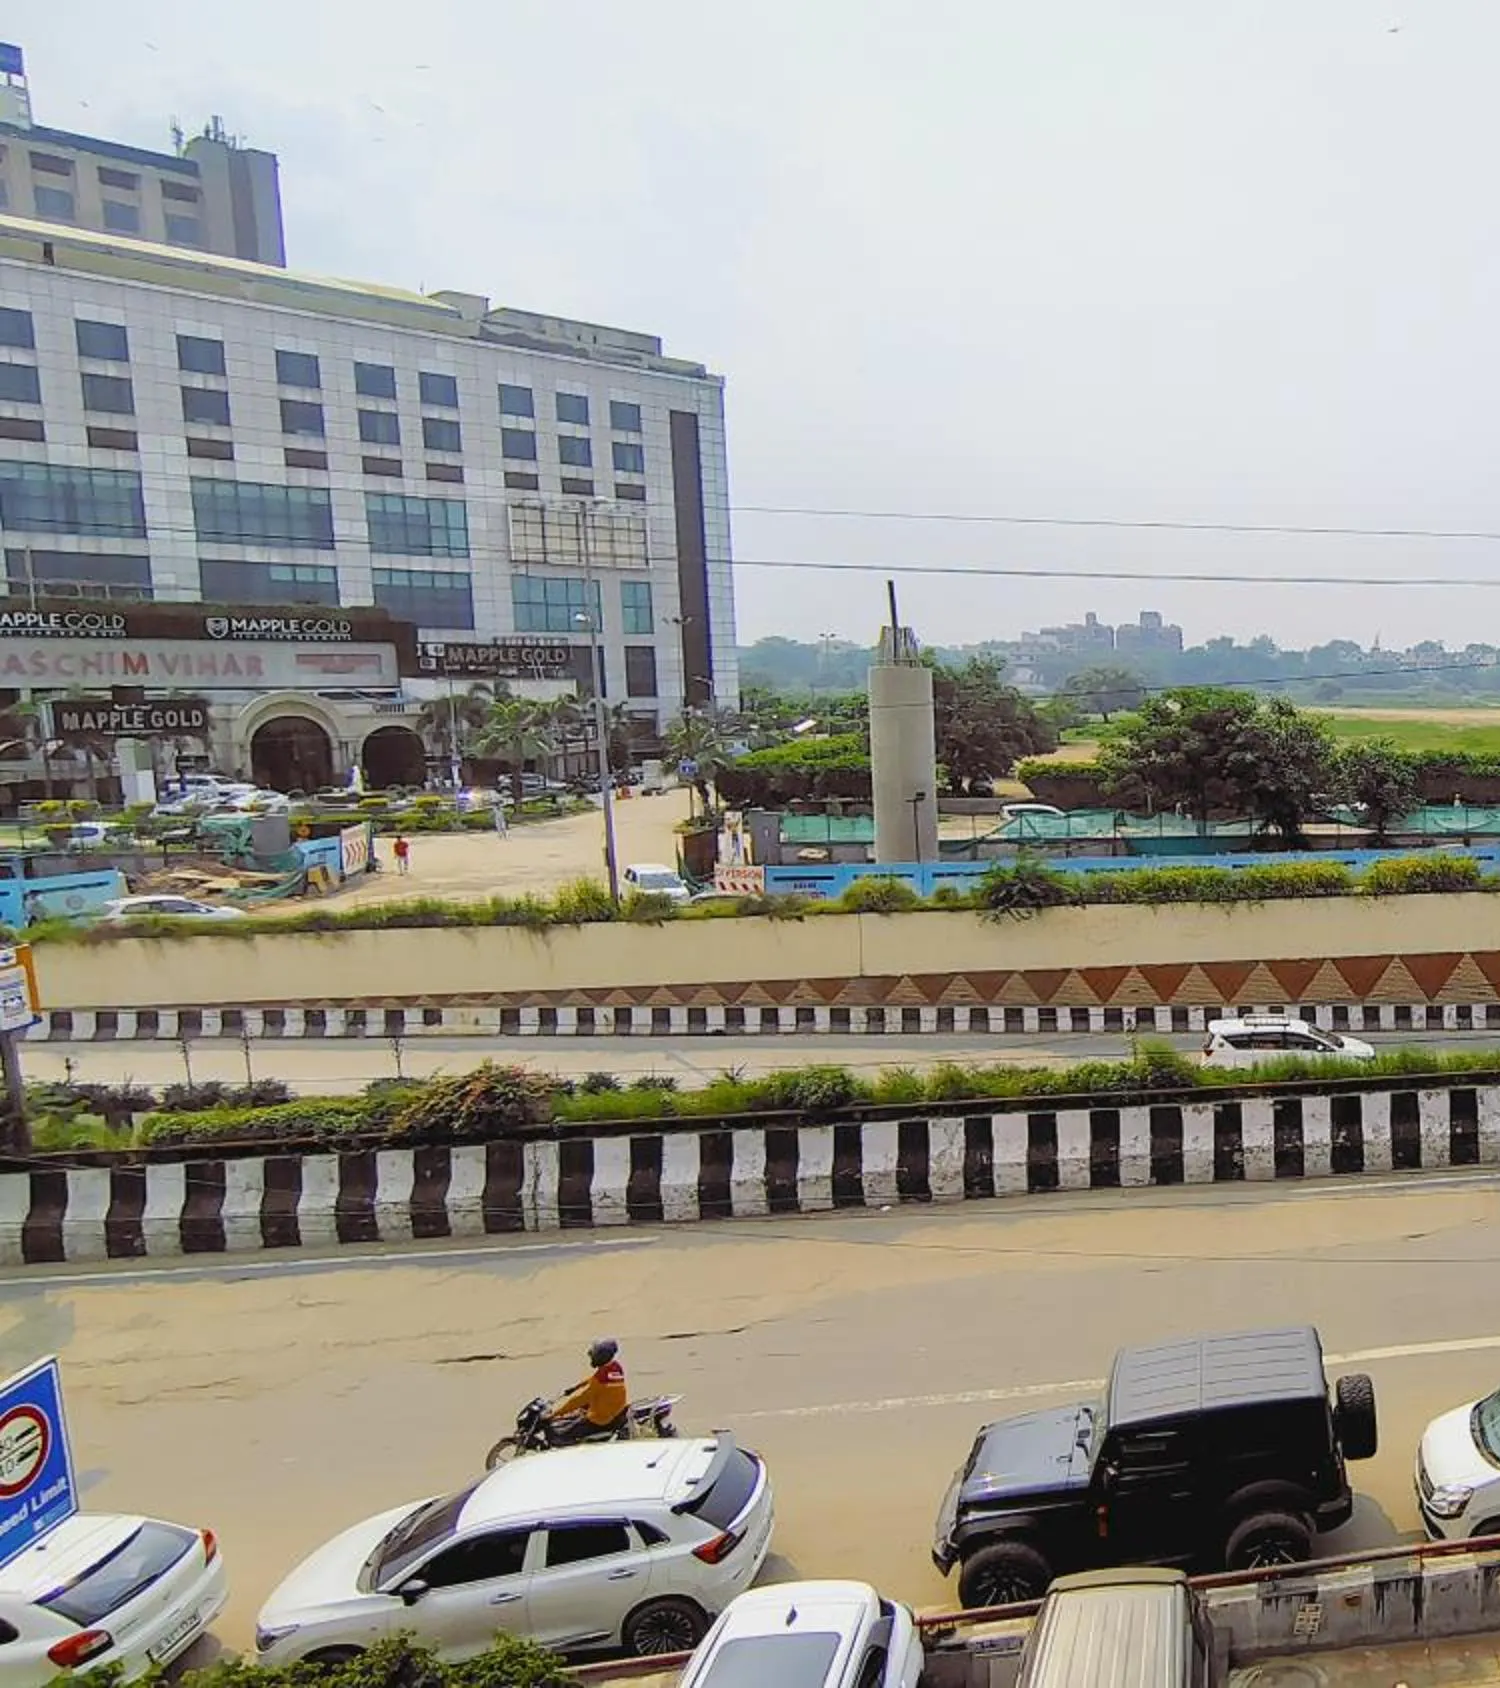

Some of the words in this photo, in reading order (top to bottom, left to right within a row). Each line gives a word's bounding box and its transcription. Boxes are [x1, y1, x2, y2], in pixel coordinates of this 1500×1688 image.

[64, 612, 125, 629] GOLD
[231, 618, 299, 633] MAPPLE
[302, 619, 351, 633] GOLD
[157, 650, 264, 676] VIHAR
[448, 647, 519, 663] MAPPLE
[521, 648, 566, 663] GOLD
[61, 711, 145, 731] MAPPLE
[151, 710, 203, 729] GOLD
[31, 1476, 67, 1512] Limit
